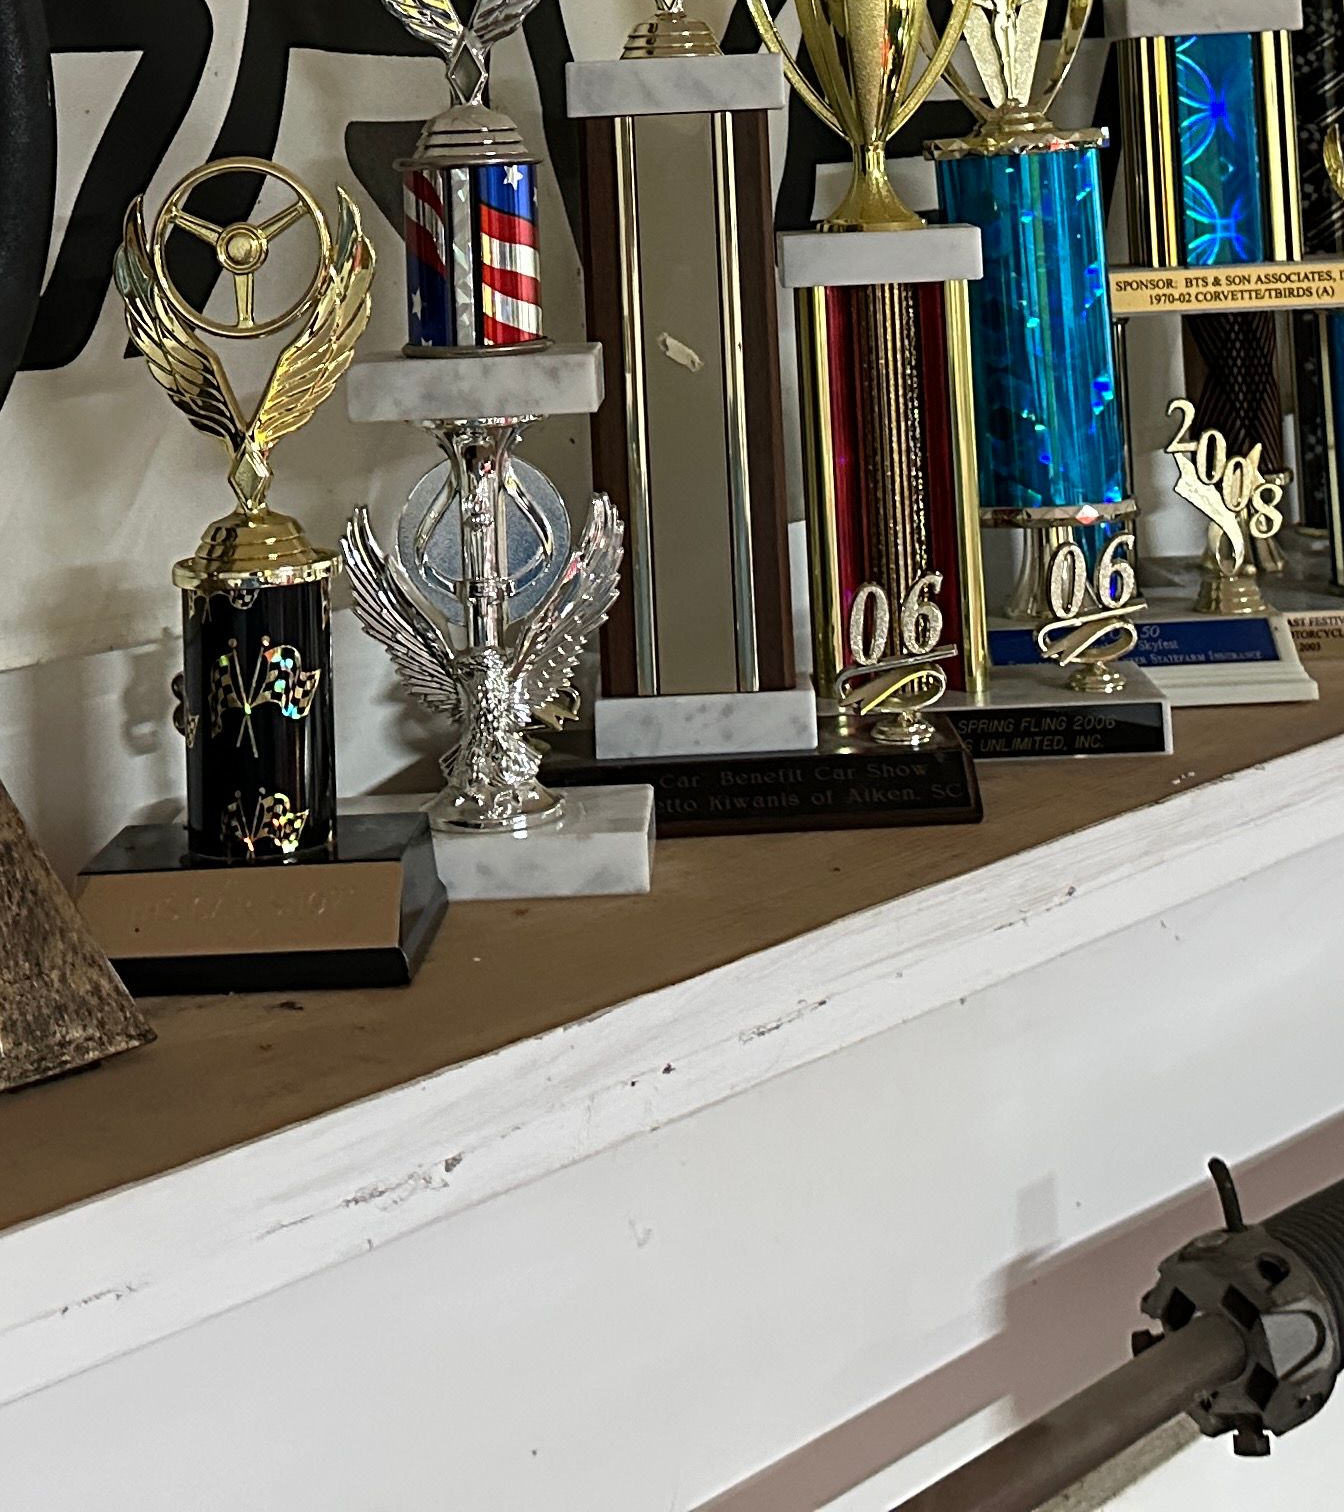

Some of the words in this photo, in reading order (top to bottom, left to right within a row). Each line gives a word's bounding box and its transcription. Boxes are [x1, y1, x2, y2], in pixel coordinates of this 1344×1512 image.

[1184, 275, 1209, 288] BTS
[1212, 275, 1222, 287] &
[1225, 274, 1252, 286] SON
[1255, 270, 1337, 285] ASSOCIATES,
[1149, 292, 1193, 305] 1970-02
[1195, 287, 1313, 303] CORVETTE/TBIRDS
[1316, 286, 1335, 299] (A)
[1165, 398, 1284, 539] 2008
[1049, 534, 1136, 620] 06
[850, 570, 945, 666] 06
[1139, 625, 1161, 638] 50
[958, 717, 1014, 734] SPRING
[1020, 716, 1067, 732] FLING
[1072, 714, 1117, 730] 2006
[1075, 734, 1105, 749] INC.
[659, 774, 700, 788] Car
[720, 768, 804, 785] Benefit
[814, 765, 856, 782] Car
[866, 761, 928, 779] Show
[710, 791, 800, 812] Kiwanis
[811, 790, 834, 807] of
[930, 783, 962, 800] SC
